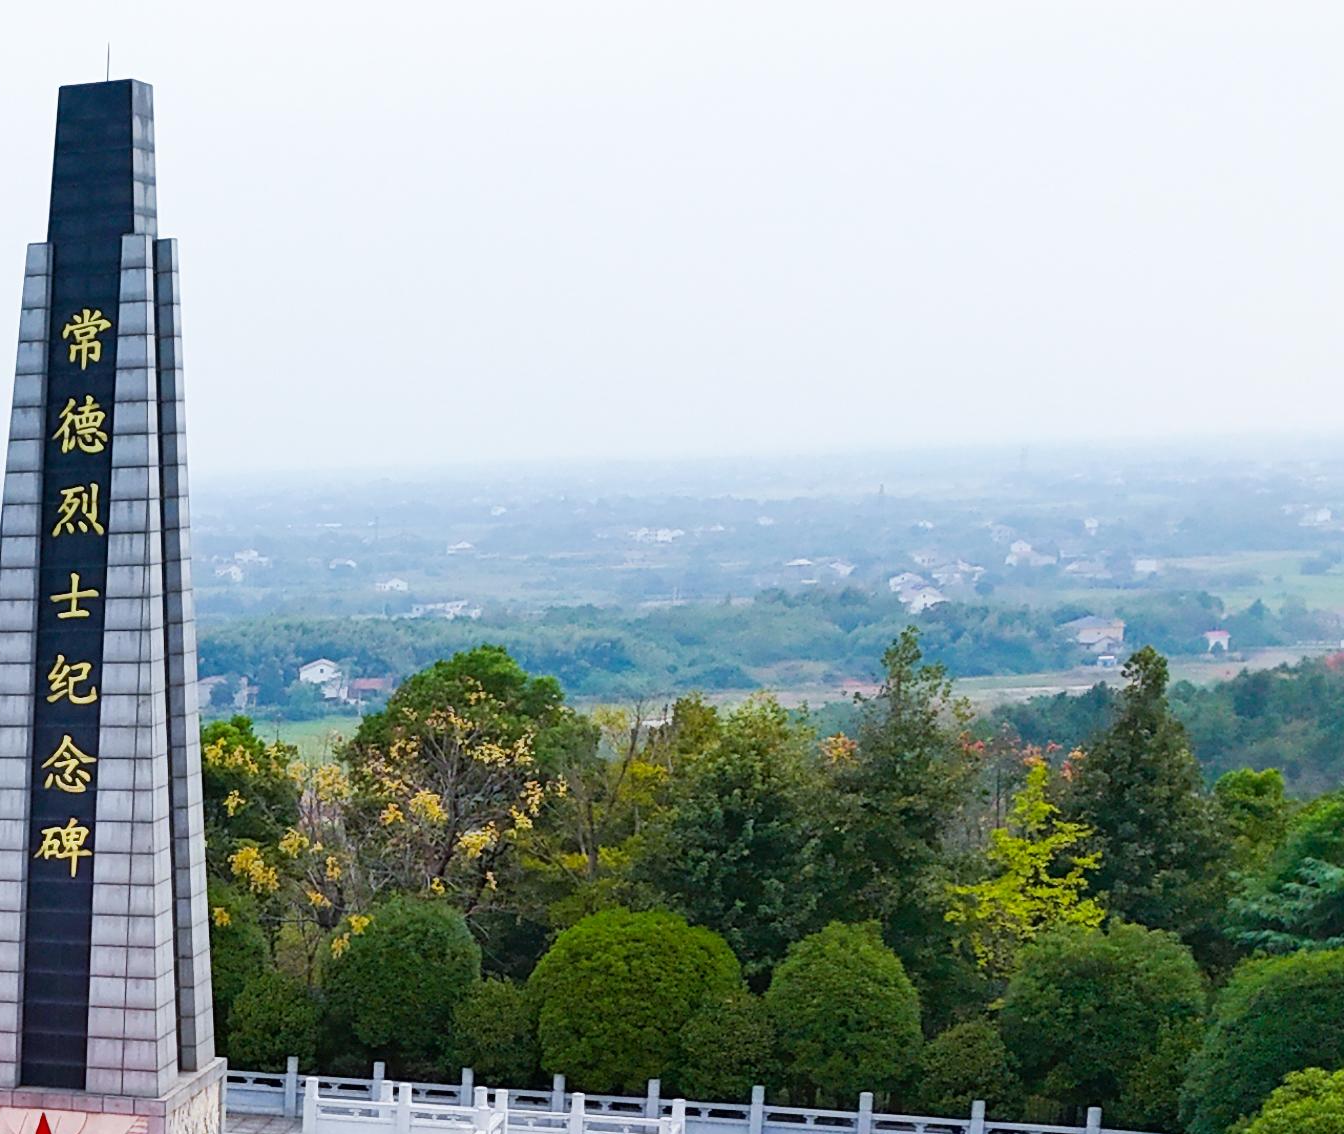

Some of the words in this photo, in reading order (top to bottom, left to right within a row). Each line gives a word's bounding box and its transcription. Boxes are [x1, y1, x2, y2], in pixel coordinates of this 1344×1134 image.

[34, 307, 112, 879] 常德烈士纪念碑
